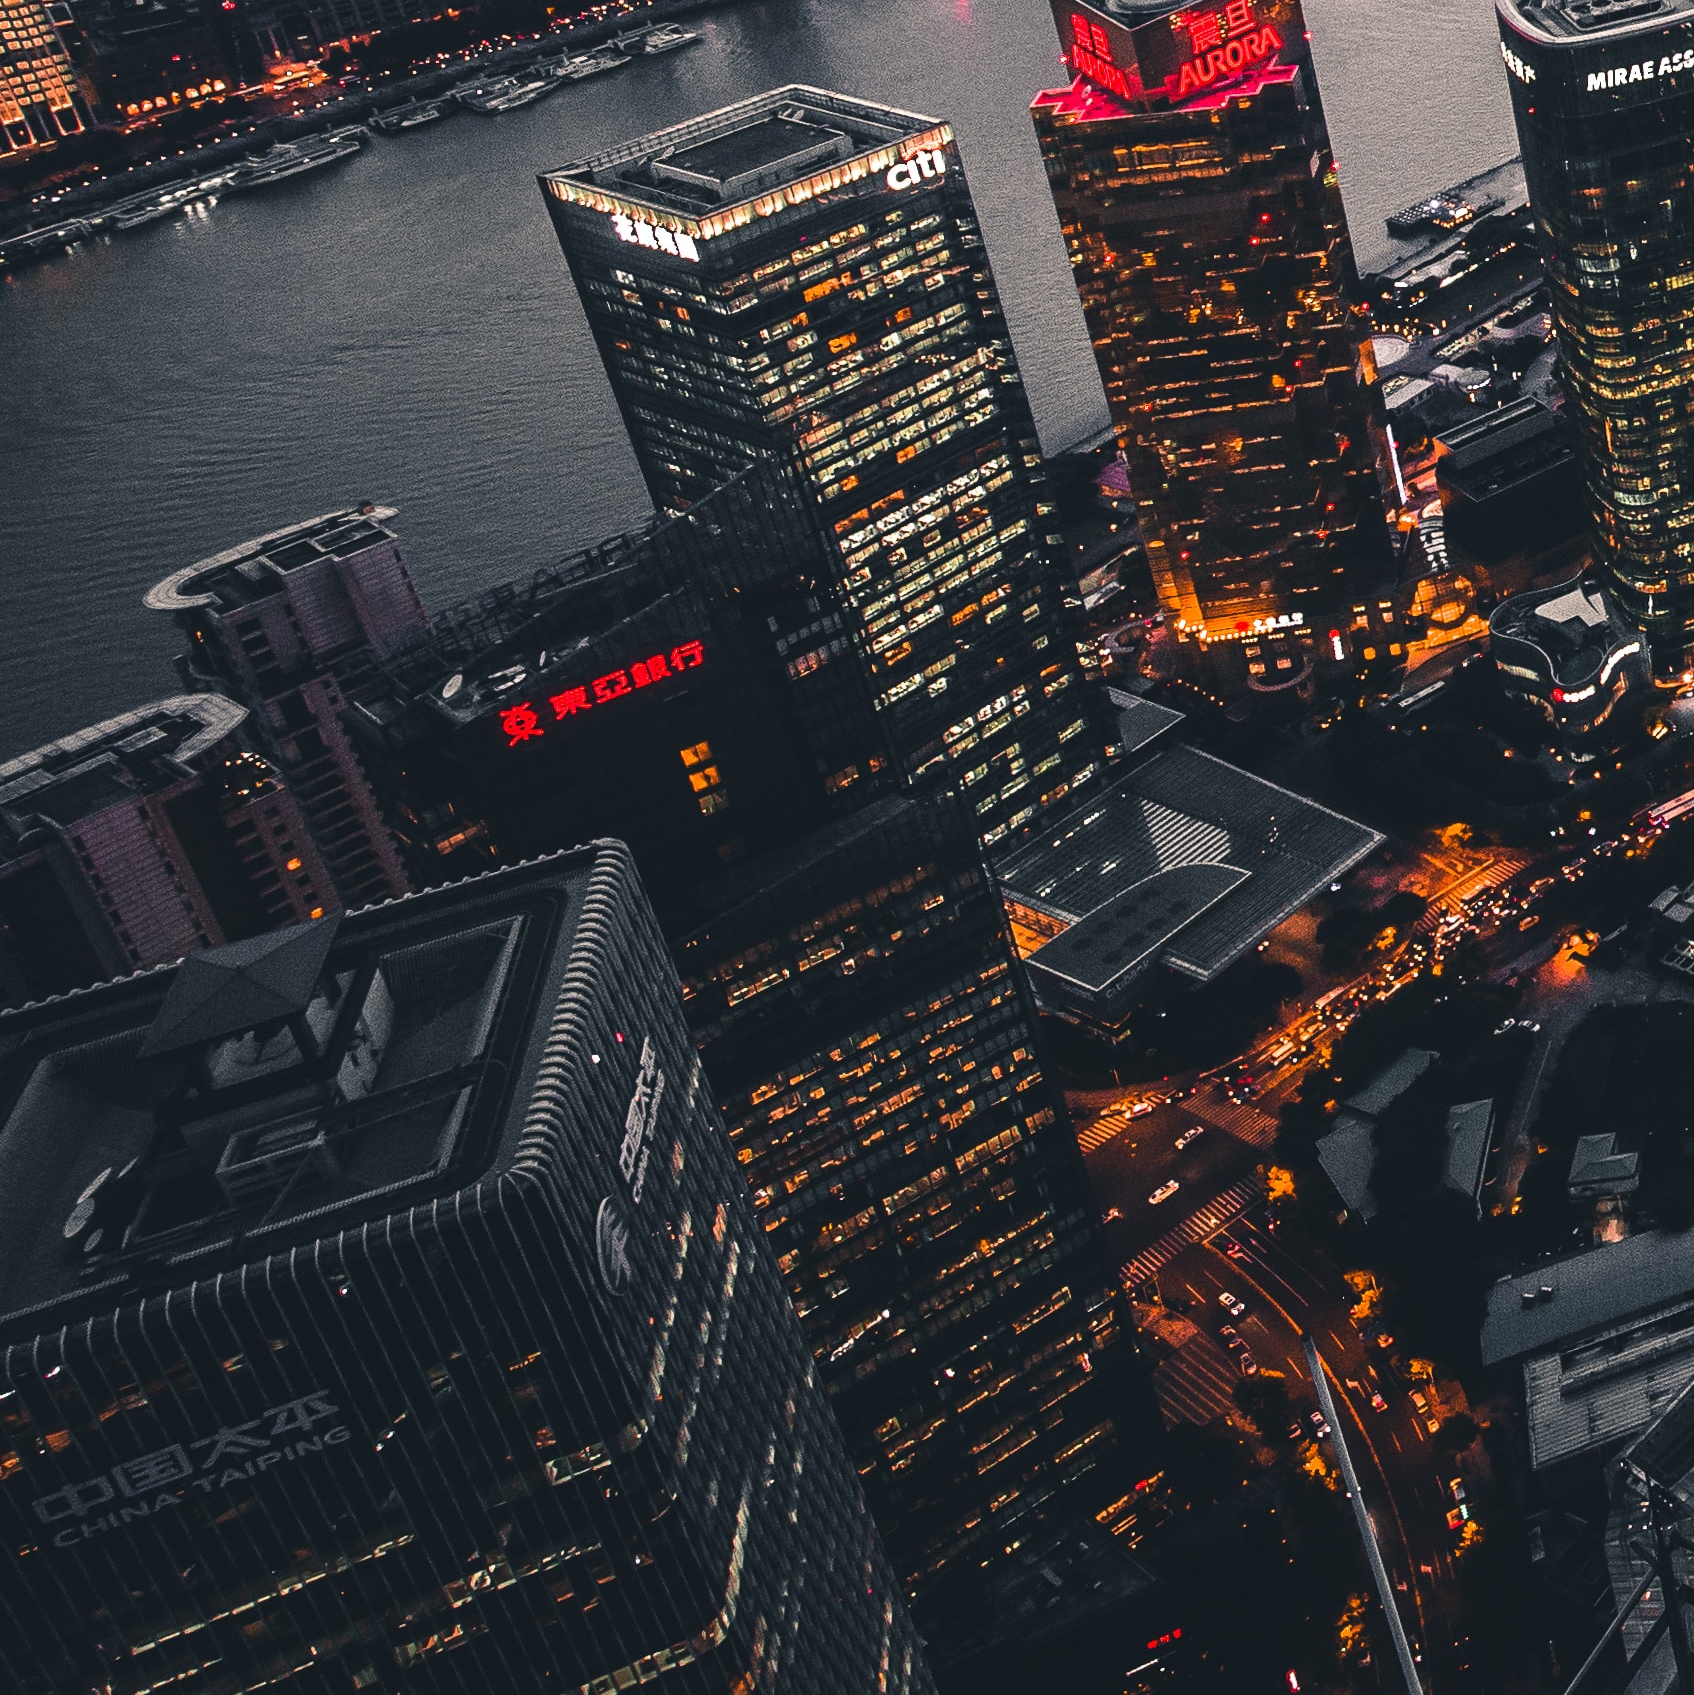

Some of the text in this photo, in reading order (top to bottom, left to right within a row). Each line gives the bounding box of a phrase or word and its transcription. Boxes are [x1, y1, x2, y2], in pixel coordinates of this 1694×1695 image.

[1070, 13, 1113, 63] 震旦
[1177, 24, 1283, 96] AURORA
[1071, 43, 1131, 101] AURORA
[1586, 60, 1655, 92] MIRAE
[886, 149, 947, 191] citi
[31, 1388, 340, 1524] 中国太平
[53, 1424, 352, 1548] CHINA TAIPING
